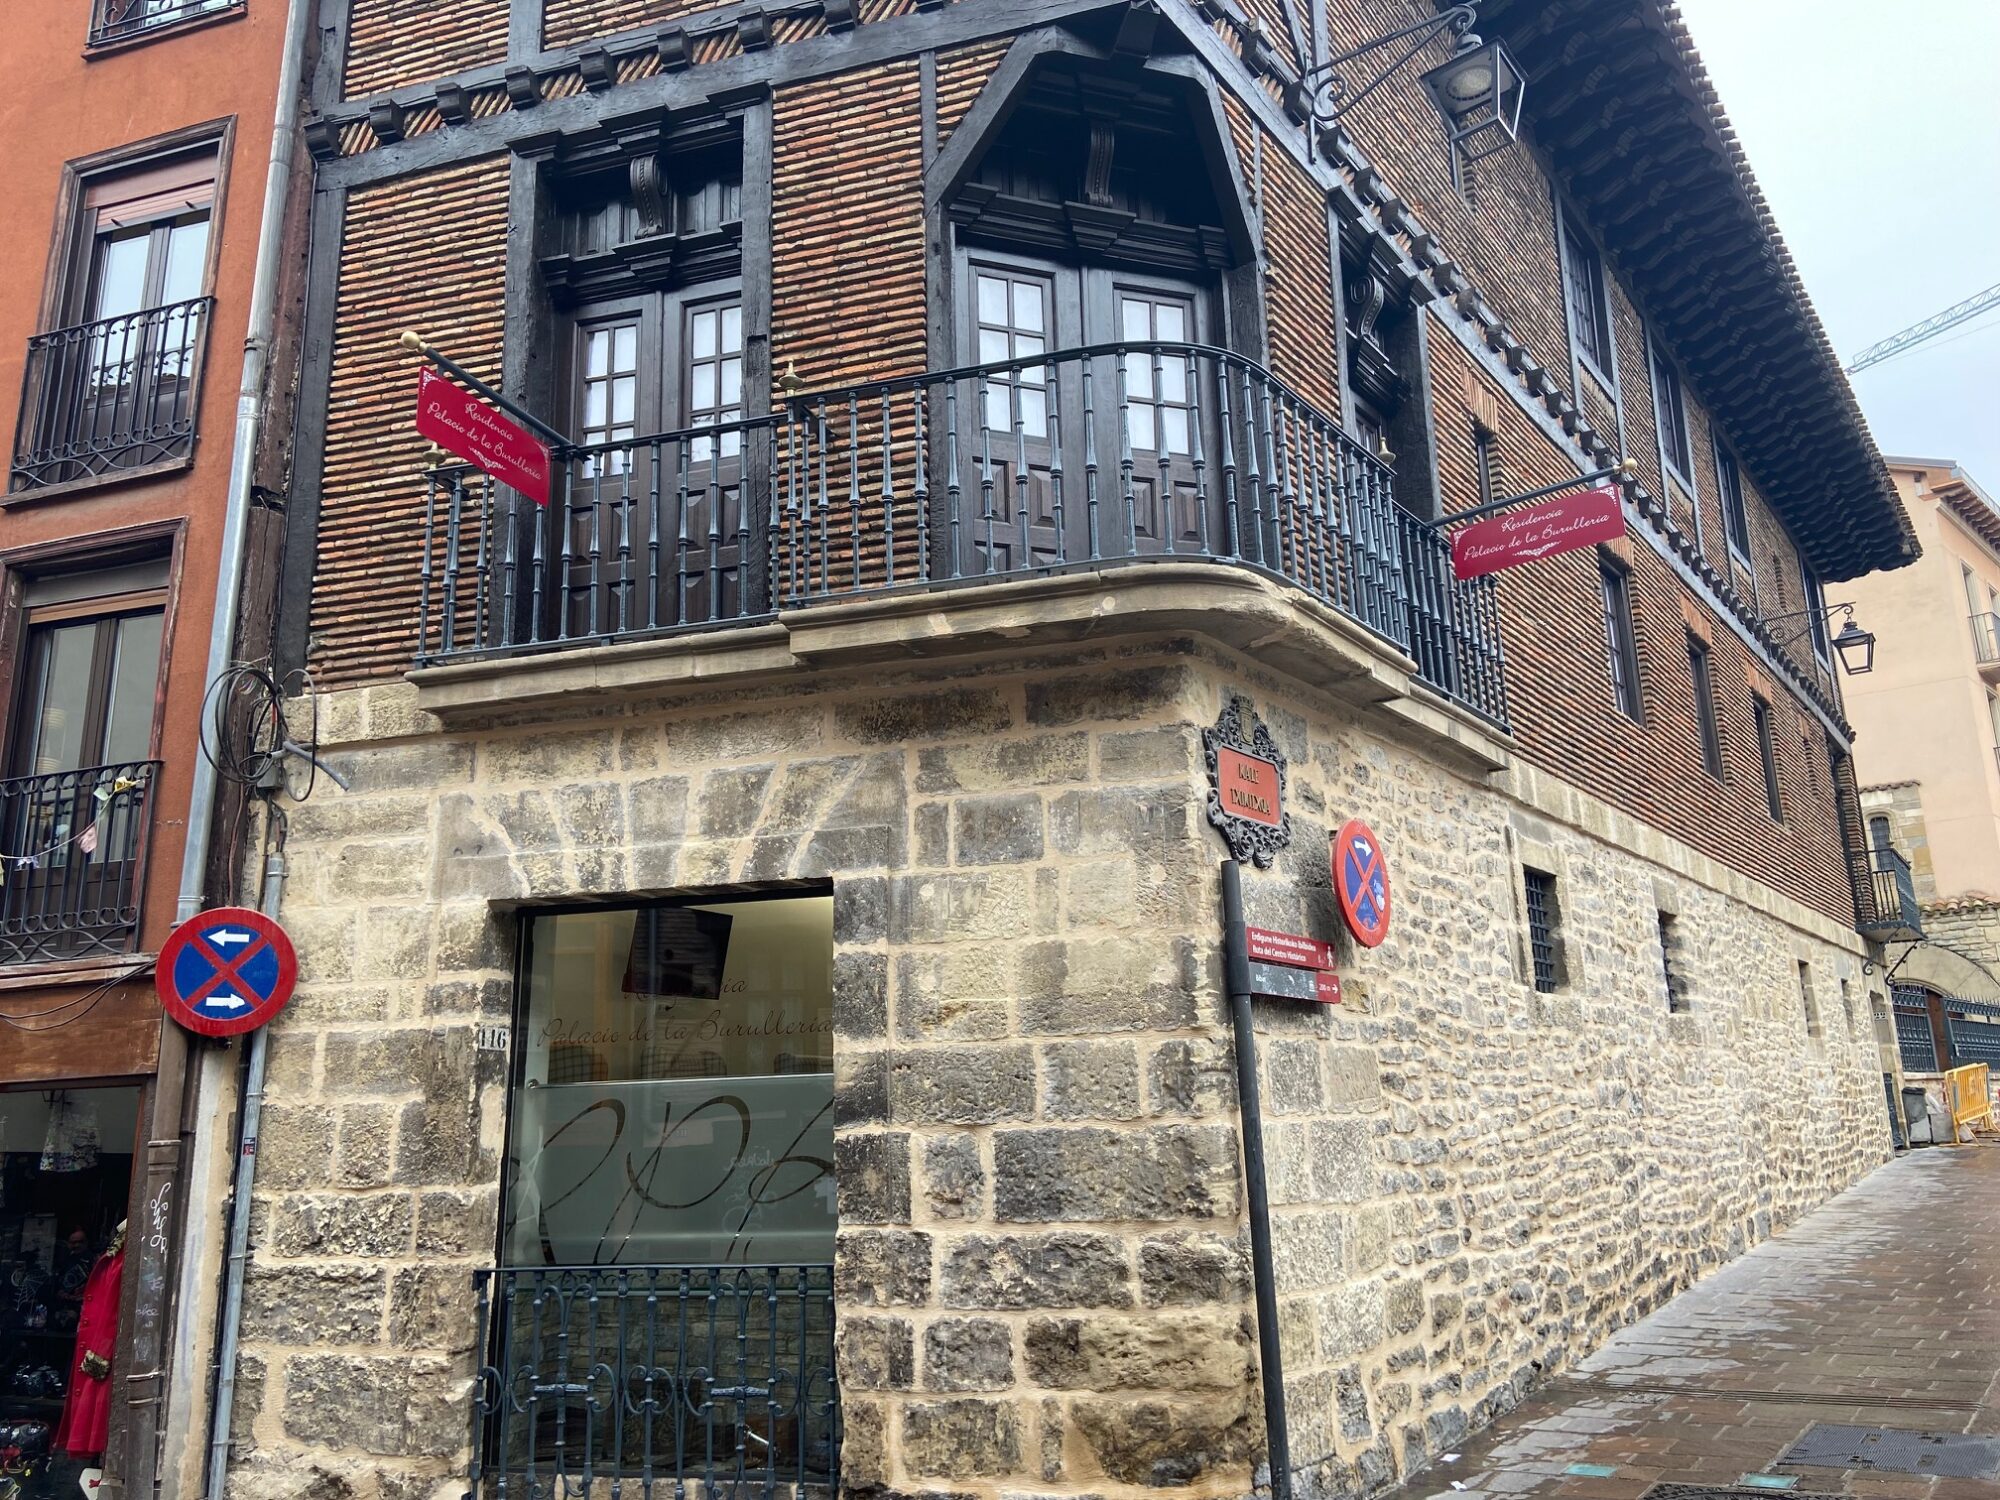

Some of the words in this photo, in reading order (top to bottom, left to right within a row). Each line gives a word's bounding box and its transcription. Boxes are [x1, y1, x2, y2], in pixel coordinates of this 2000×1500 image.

[427, 401, 465, 433] Palacio
[466, 427, 479, 442] de
[481, 433, 492, 449] la
[465, 403, 514, 441] Residencia
[1501, 508, 1565, 532] Residencia
[1463, 543, 1506, 561] Palacio
[1508, 538, 1523, 550] de
[1525, 531, 1539, 544] la
[1252, 932, 1272, 944] Erdigune
[1252, 945, 1264, 954] Ruta
[1272, 948, 1286, 958] Centro
[481, 1028, 507, 1049] 116
[536, 1017, 620, 1048] Palacio
[628, 1016, 655, 1042] de
[664, 1018, 690, 1041] la
